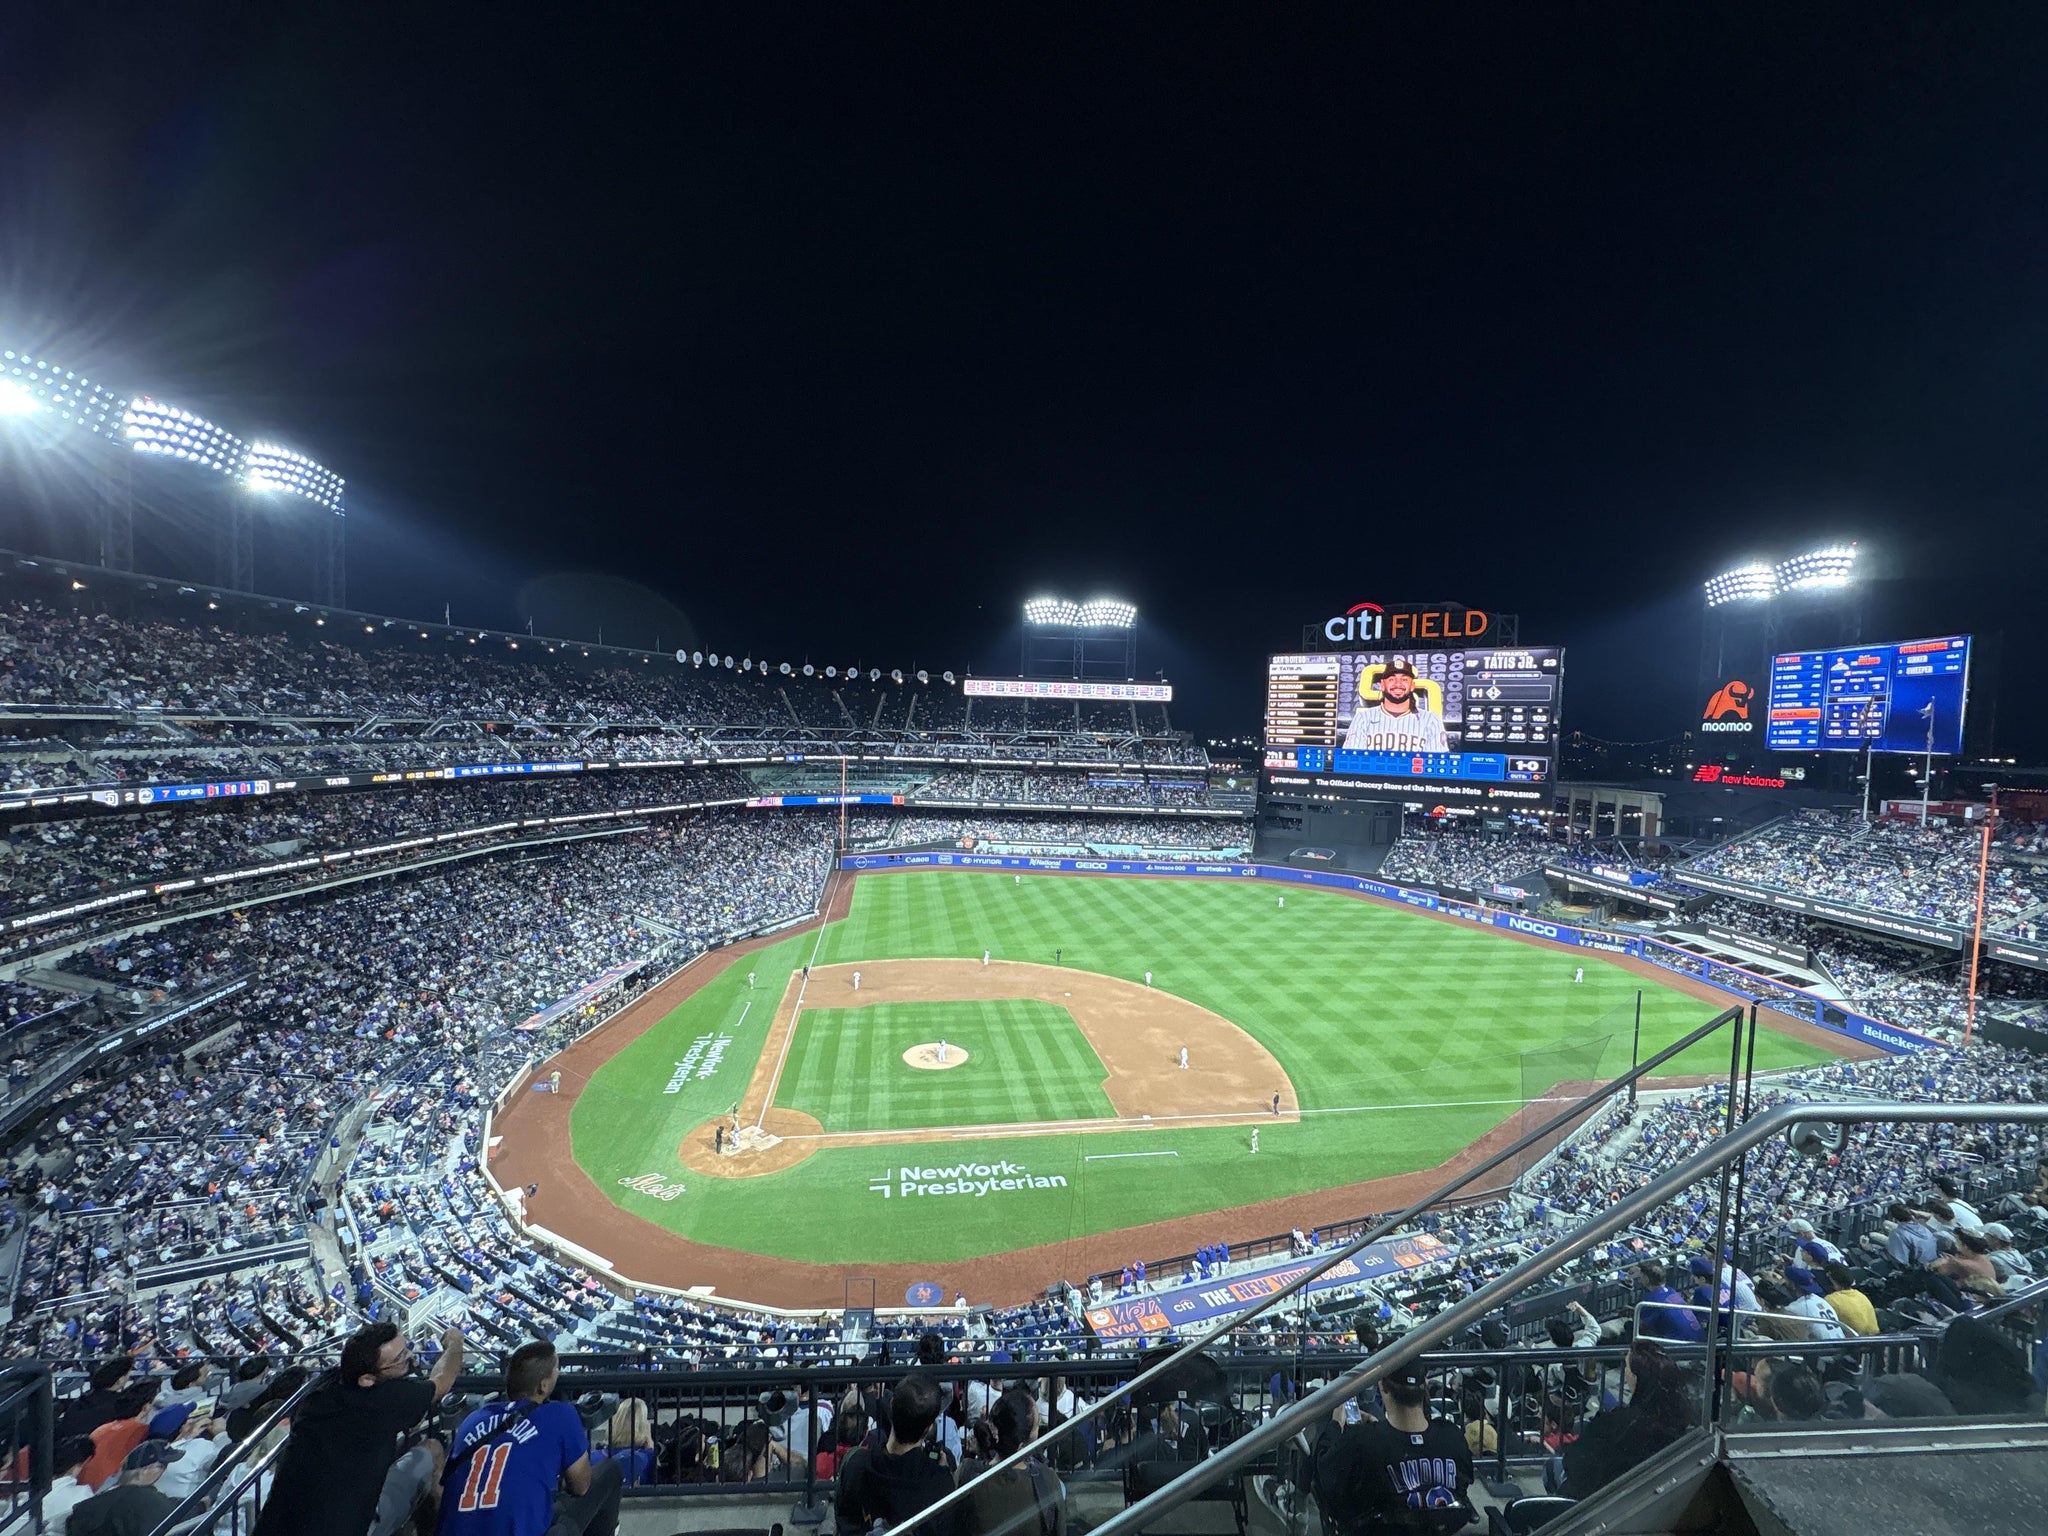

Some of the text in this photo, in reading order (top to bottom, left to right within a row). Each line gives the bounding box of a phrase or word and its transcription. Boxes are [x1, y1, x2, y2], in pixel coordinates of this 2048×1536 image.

[1325, 610, 1488, 642] citi FIELD
[1341, 655, 1384, 664] SAN
[1484, 656, 1516, 669] TATIS
[1518, 656, 1538, 669] JR.
[1542, 659, 1557, 667] 23
[1702, 722, 1753, 732] moomoo
[1366, 733, 1427, 751] PADRES
[1516, 760, 1539, 771] 1-0
[325, 777, 350, 786] TATIS
[1329, 780, 1354, 788] Official
[1356, 780, 1382, 790] Grocery
[1426, 786, 1442, 794] New
[1722, 774, 1785, 788] new balance
[124, 792, 134, 802] 2
[162, 790, 170, 798] 7
[1076, 862, 1108, 870] GEICO
[1242, 867, 1256, 876] citi
[1364, 884, 1386, 894] DELTA
[12, 919, 26, 928] The
[26, 912, 50, 923] Official
[50, 908, 74, 919] Grocery
[75, 903, 90, 912] Store
[120, 892, 132, 900] York
[132, 889, 147, 897] Mets
[1509, 917, 1558, 937] NOCO
[1825, 906, 1846, 917] Official
[1846, 912, 1868, 923] Grocery
[1868, 918, 1884, 926] Store
[1893, 922, 1904, 930] the
[1904, 926, 1919, 934] New
[1919, 928, 1935, 938] York
[1936, 932, 1954, 942] Mets
[1772, 1004, 1816, 1024] CADILLAC
[662, 1040, 712, 1094] Presbyterian
[900, 1160, 1026, 1182] NewYork-
[618, 1172, 686, 1201] Mets
[900, 1174, 1068, 1197] Presbyterian
[1364, 1256, 1384, 1267] citi
[1200, 1278, 1274, 1308] THE NEW
[1173, 1301, 1196, 1312] citi
[1102, 1322, 1138, 1338] NYM
[458, 1442, 512, 1512] 11
[1387, 1458, 1457, 1494] LINDOR
